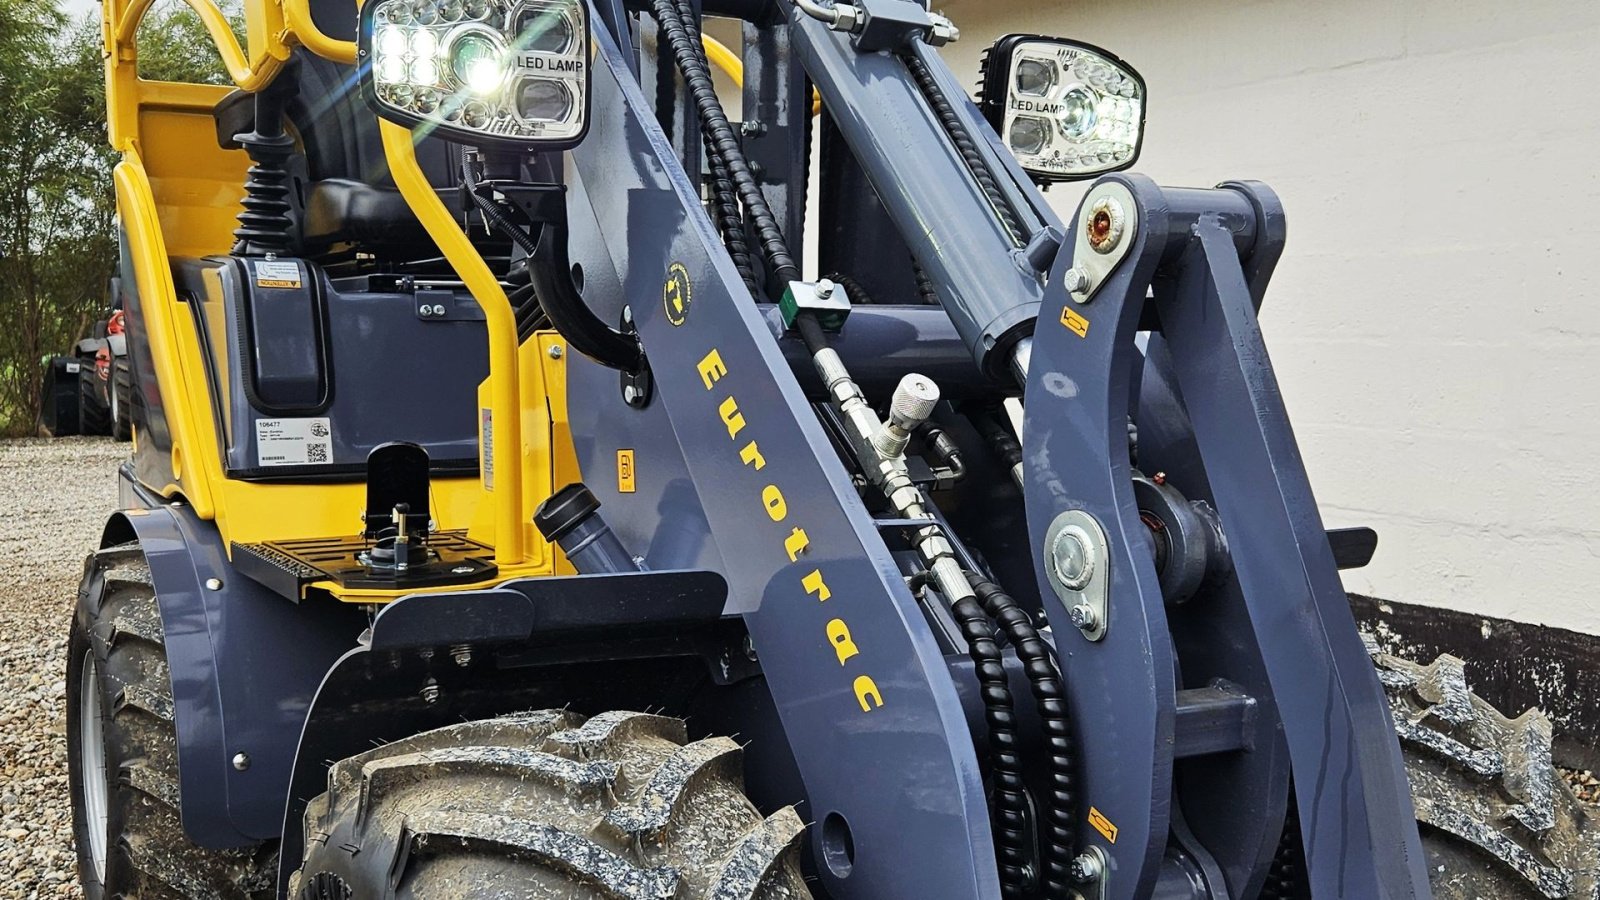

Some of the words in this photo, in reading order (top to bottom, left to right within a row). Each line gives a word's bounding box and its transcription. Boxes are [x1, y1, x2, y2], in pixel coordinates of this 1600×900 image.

[517, 55, 543, 69] LED
[548, 58, 583, 73] LAMP
[1011, 100, 1033, 111] LED
[1036, 102, 1066, 114] LAMP
[696, 348, 884, 713] Eurotrac
